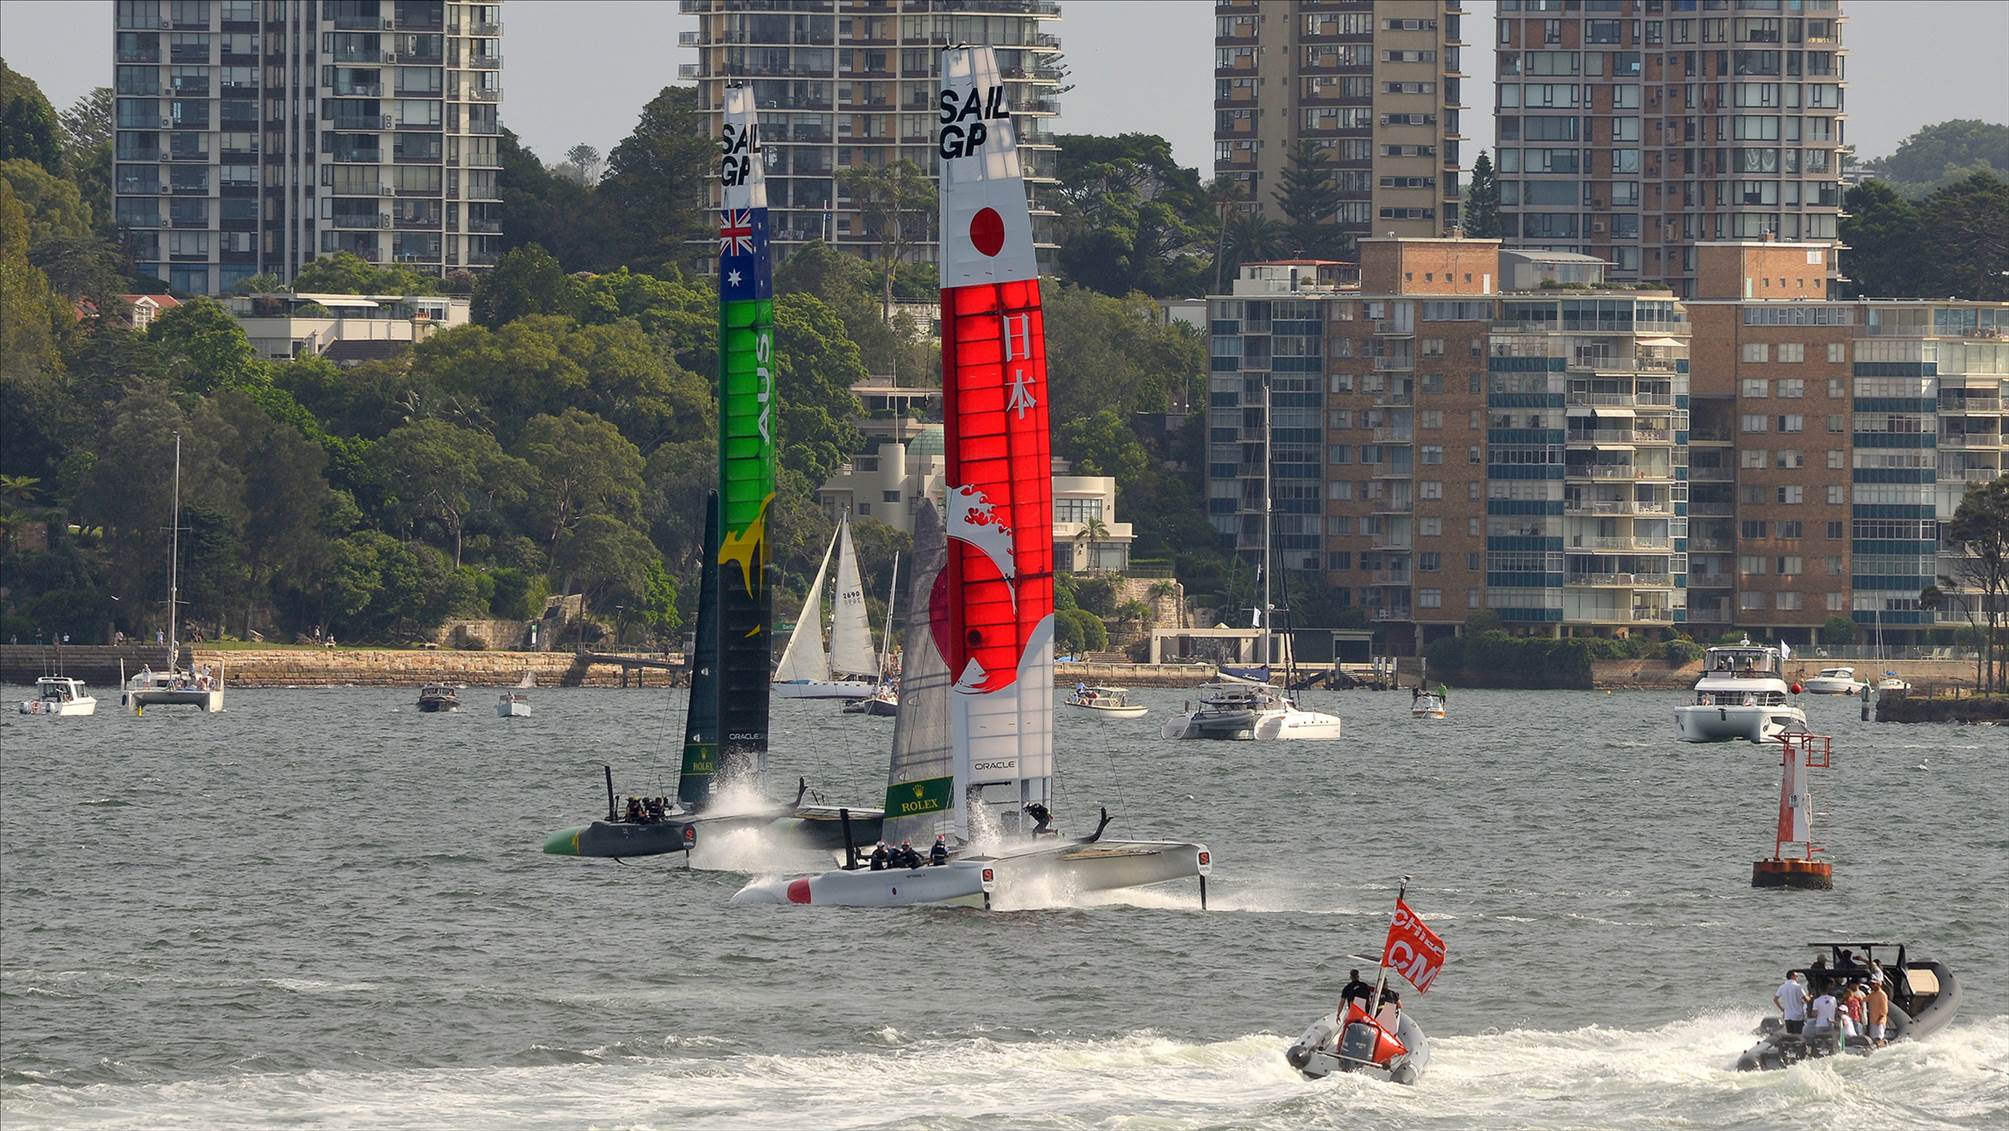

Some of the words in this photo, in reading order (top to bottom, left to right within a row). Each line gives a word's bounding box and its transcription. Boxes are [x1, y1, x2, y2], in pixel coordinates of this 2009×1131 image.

[940, 86, 1010, 124] SAIL
[722, 124, 761, 154] SAIL
[940, 123, 987, 159] GP
[721, 155, 750, 187] GP
[1003, 313, 1037, 419] 日本
[756, 334, 770, 445] AUS
[693, 762, 713, 771] ROLEX
[974, 761, 1015, 771] ORACLE
[901, 799, 938, 812] ROLEX
[1388, 940, 1438, 987] CM
